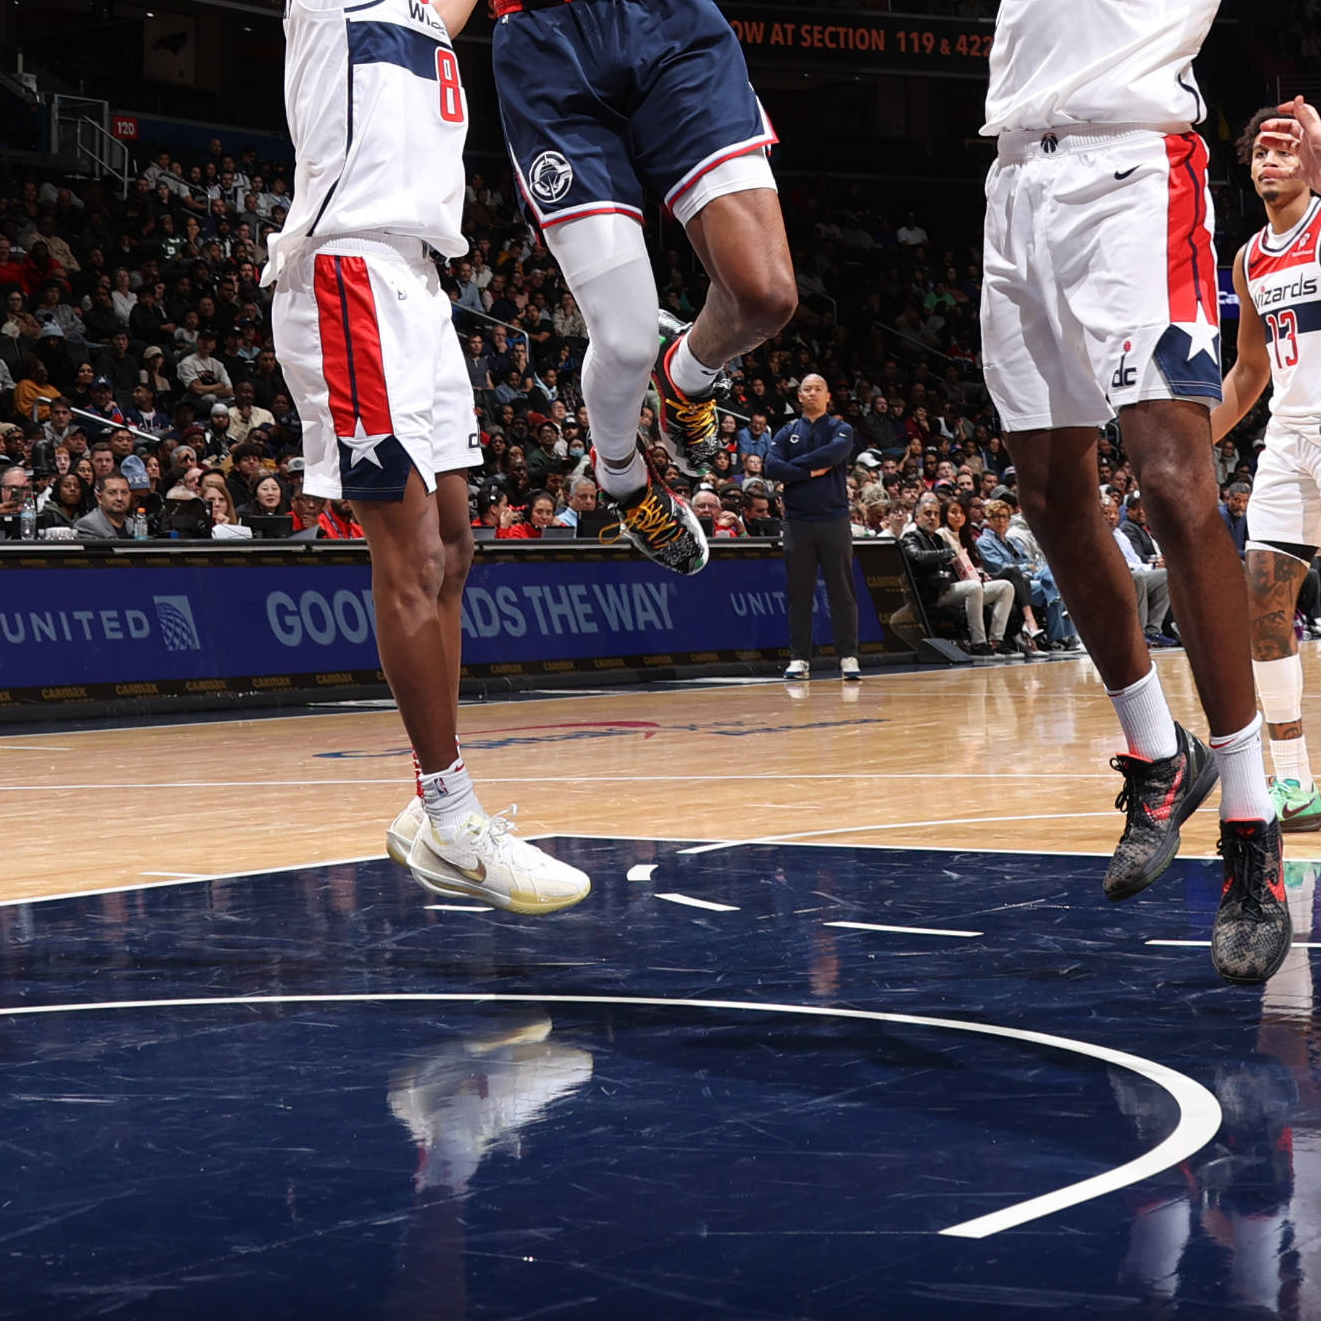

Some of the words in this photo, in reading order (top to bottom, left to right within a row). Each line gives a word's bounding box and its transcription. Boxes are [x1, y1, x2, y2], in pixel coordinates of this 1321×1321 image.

[730, 20, 764, 44] OW
[769, 22, 796, 46] AT
[800, 24, 886, 51] SECTION
[896, 30, 935, 54] 119
[939, 37, 951, 56] &
[955, 34, 993, 57] 422
[116, 121, 135, 136] 120
[1265, 309, 1299, 370] 13
[266, 587, 375, 648] GOO
[461, 586, 528, 639] ADS
[527, 582, 598, 636] THE
[596, 581, 675, 634] WAY
[730, 590, 818, 617] UNIT
[0, 609, 151, 645] UNITED
